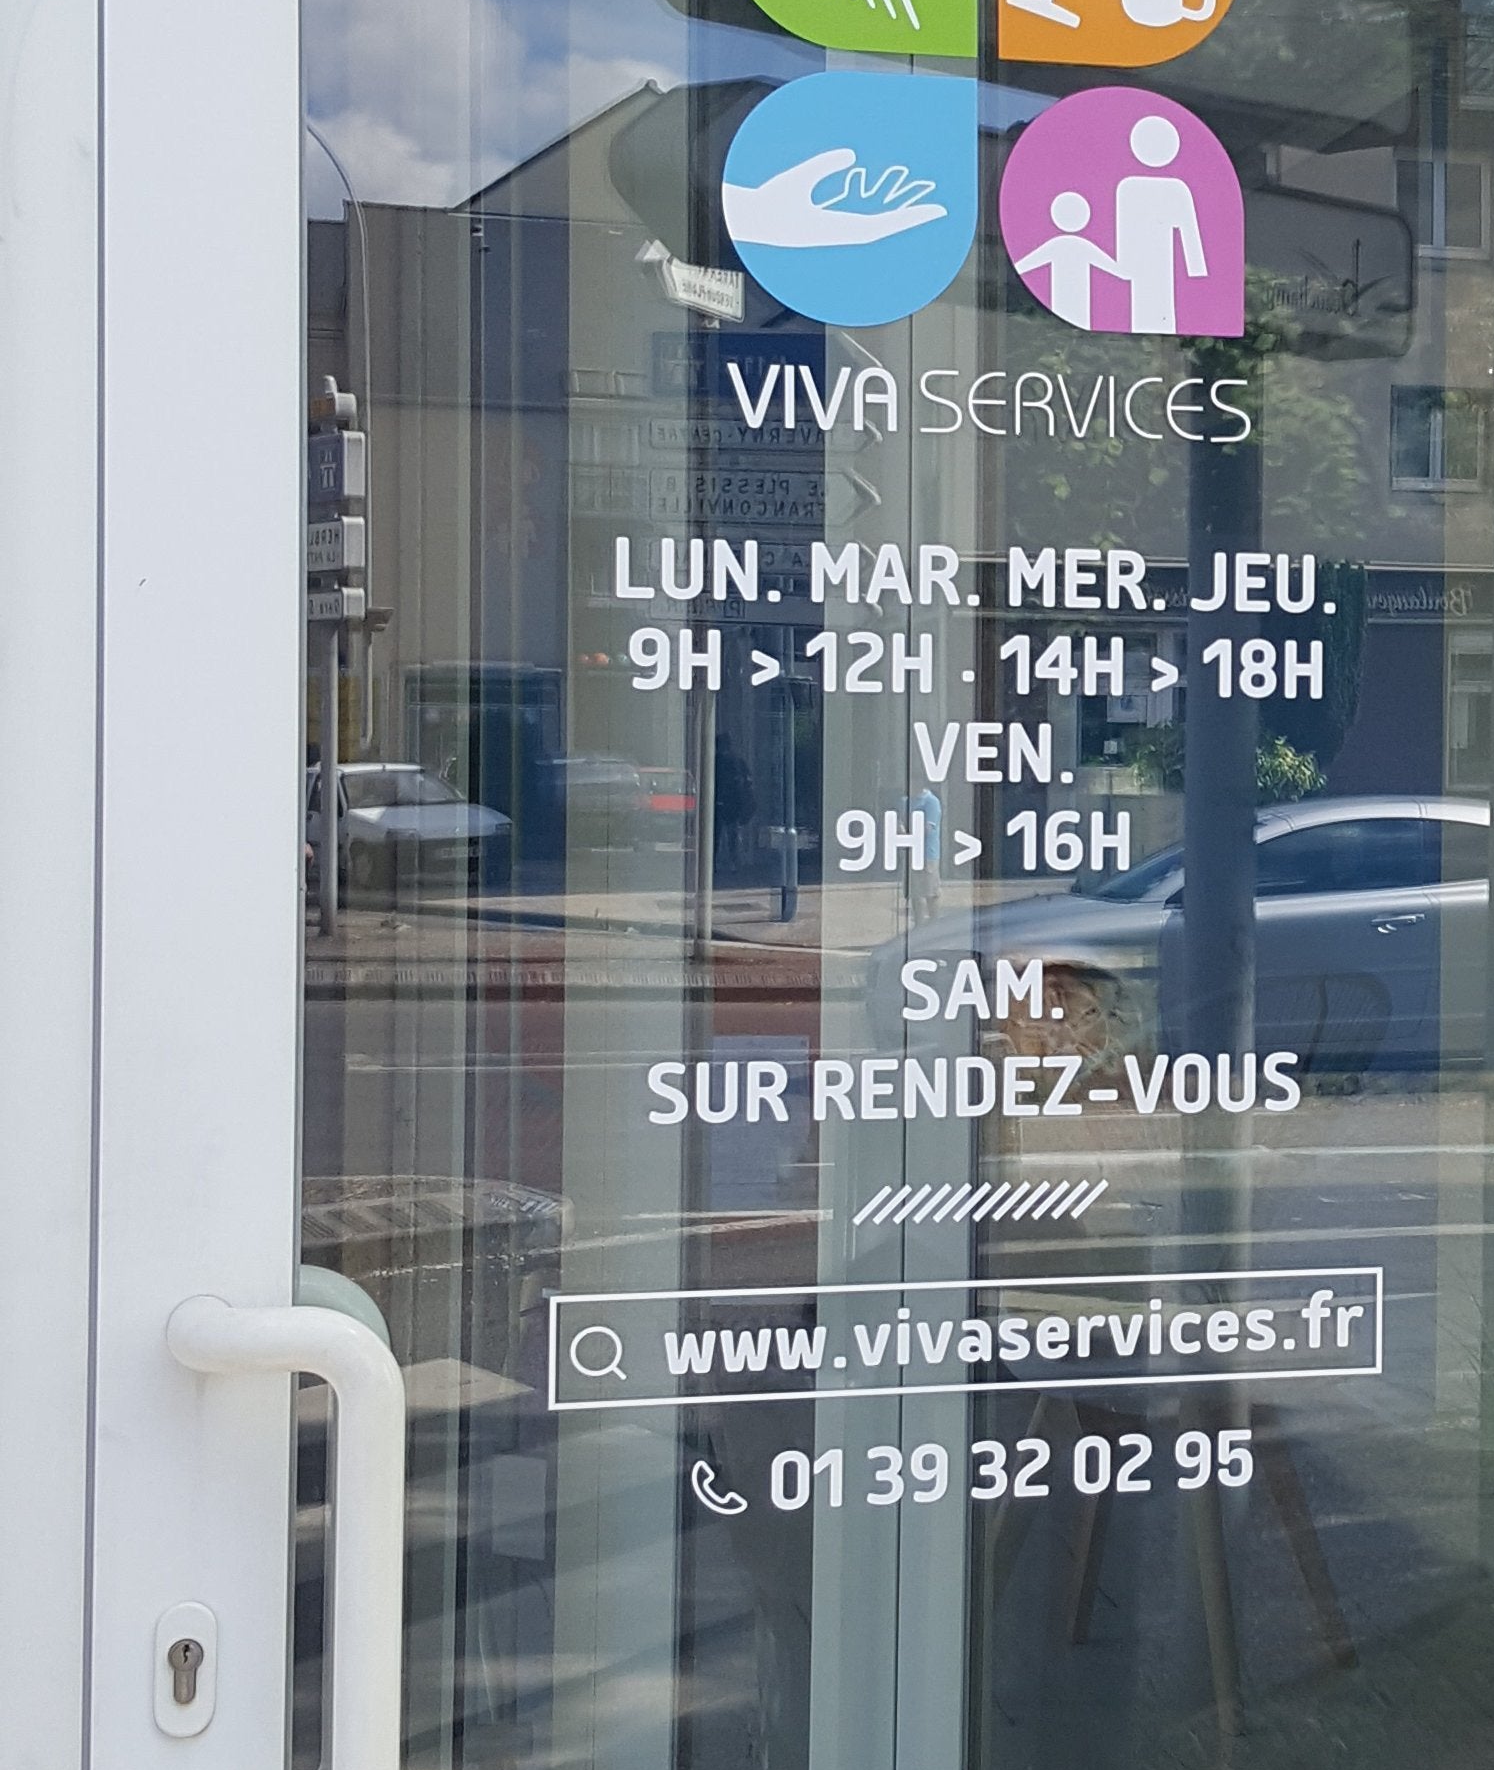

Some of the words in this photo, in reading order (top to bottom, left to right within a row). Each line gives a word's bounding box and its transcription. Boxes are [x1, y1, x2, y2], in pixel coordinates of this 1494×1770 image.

[726, 362, 898, 432] VIVA
[919, 369, 1251, 443] SERVICES
[615, 536, 781, 603] LUN.
[811, 541, 980, 609] MAR.
[1009, 546, 1166, 611] MER.
[1190, 552, 1336, 614] JEU.
[629, 627, 721, 691] 9H
[806, 631, 933, 694] 12H
[1000, 634, 1124, 696] 14H
[1203, 638, 1323, 699] 18H
[913, 721, 1074, 784] VEN.
[836, 809, 925, 872] 9H
[1006, 810, 1130, 871] 16H
[900, 958, 1065, 1021] SAM.
[647, 1060, 789, 1125] SUR
[813, 1051, 1301, 1121] RENDEZ-VOUS
[663, 1289, 1364, 1375] www.vivaservices.fr
[771, 1448, 843, 1511] 01
[866, 1443, 949, 1506] 39
[970, 1438, 1051, 1500] 32
[1073, 1433, 1153, 1495] 02
[1175, 1429, 1253, 1490] 95
